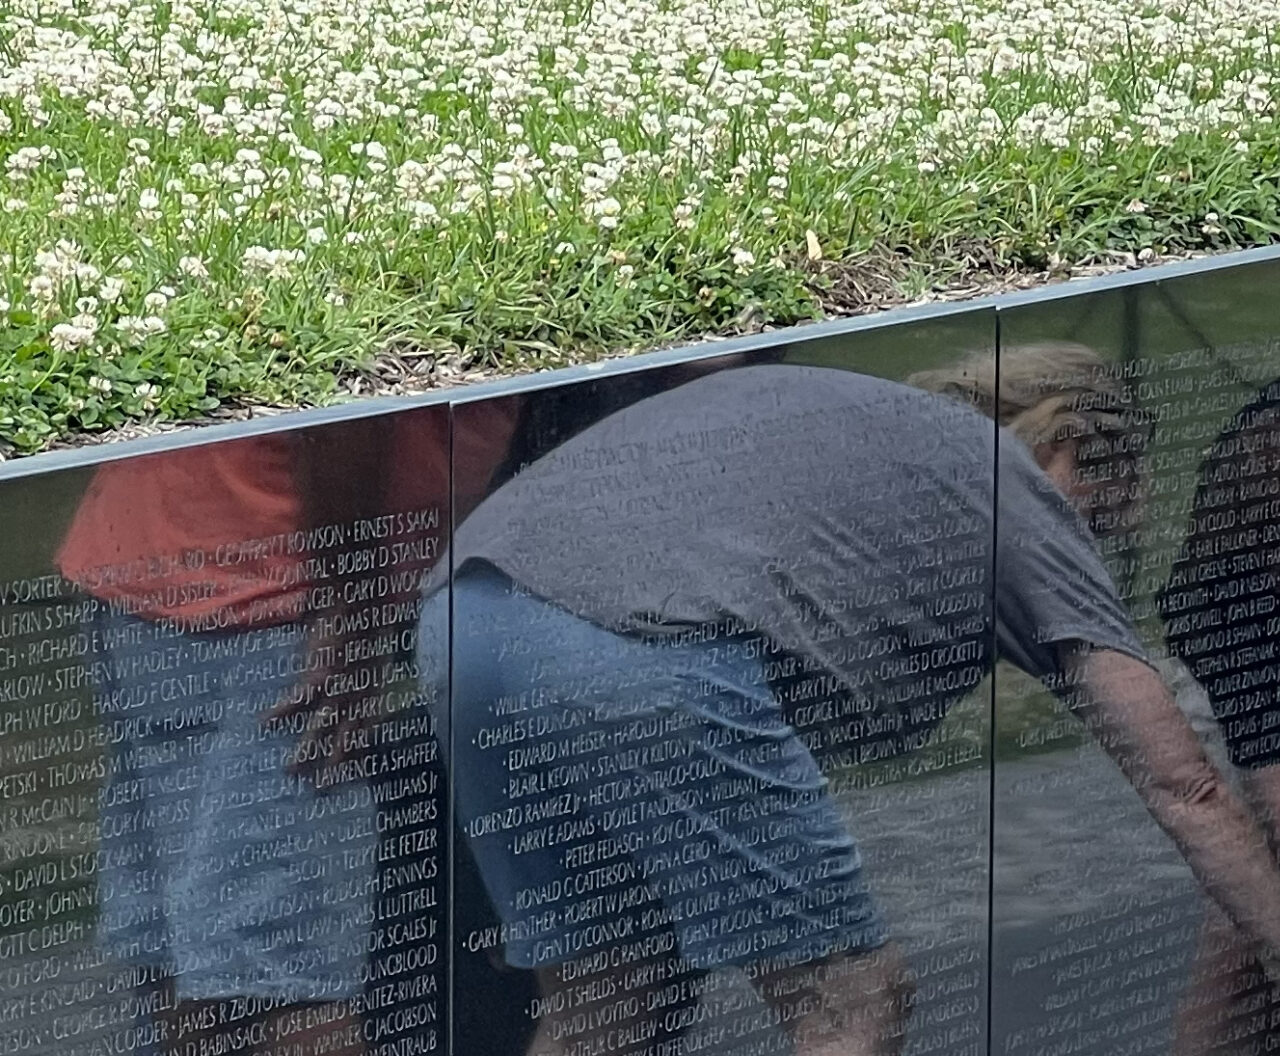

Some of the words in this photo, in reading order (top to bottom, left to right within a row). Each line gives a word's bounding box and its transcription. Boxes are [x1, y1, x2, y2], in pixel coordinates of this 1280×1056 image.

[354, 515, 397, 542] ERNEST
[398, 514, 406, 534] S
[407, 508, 439, 532] SAKAI
[338, 549, 376, 575] BOBBY
[380, 546, 389, 567] D
[393, 537, 439, 565] STANLEY
[1232, 552, 1260, 574] STEVEN
[1214, 581, 1239, 601] DAVID
[881, 654, 920, 680] CHARLES
[922, 652, 929, 671] D
[931, 641, 977, 668] CROCKETT
[1215, 674, 1241, 696] OLIVER
[345, 726, 371, 751] EARL
[374, 724, 380, 745] T
[380, 714, 428, 743] PELHAM
[479, 720, 526, 750] CHARLES
[529, 718, 534, 738] E
[537, 705, 586, 736] DUNCAN
[1261, 709, 1280, 731] JERRY
[316, 755, 378, 788] LAWRENCE
[380, 752, 389, 773] A
[391, 741, 437, 771] SHAFFER
[509, 741, 555, 771] EDWARD
[558, 737, 569, 759] M
[572, 729, 605, 755] HEISER
[509, 773, 537, 799] BLAIR
[540, 771, 546, 791] L
[548, 760, 589, 789] KEOWN
[377, 799, 437, 833] CHAMBERS
[470, 806, 522, 838] LORENZO
[525, 794, 571, 824] RAMIREZ
[514, 827, 547, 854] LARRY
[549, 825, 554, 845] E
[556, 815, 594, 843] ADAMS
[603, 803, 637, 831] DOYLE
[639, 801, 645, 821] T
[647, 786, 703, 819] ANDERSON
[379, 838, 396, 861] LEE
[400, 828, 437, 856] FETZER
[565, 843, 594, 869] PETER
[597, 829, 643, 860] FEDASCH
[516, 880, 561, 910] RONALD
[575, 860, 635, 894] CATTERSON
[532, 936, 563, 965] JOHN
[564, 934, 570, 954] T
[562, 950, 607, 981] EDWARD
[621, 931, 674, 964] RAINFORD
[276, 1010, 302, 1039] JOSE
[307, 998, 346, 1028] EMILIO
[350, 973, 436, 1016] BENITEZ-RIVERA
[531, 991, 565, 1019] DAVID
[567, 988, 574, 1008] T
[576, 975, 616, 1006] SHIELDS
[314, 1023, 361, 1056] WARNER
[364, 1020, 372, 1041] C
[375, 1001, 436, 1040] JACOBSON
[553, 1012, 586, 1040] DAVID
[588, 1010, 593, 1030] L
[596, 996, 639, 1028] VOYTKO
